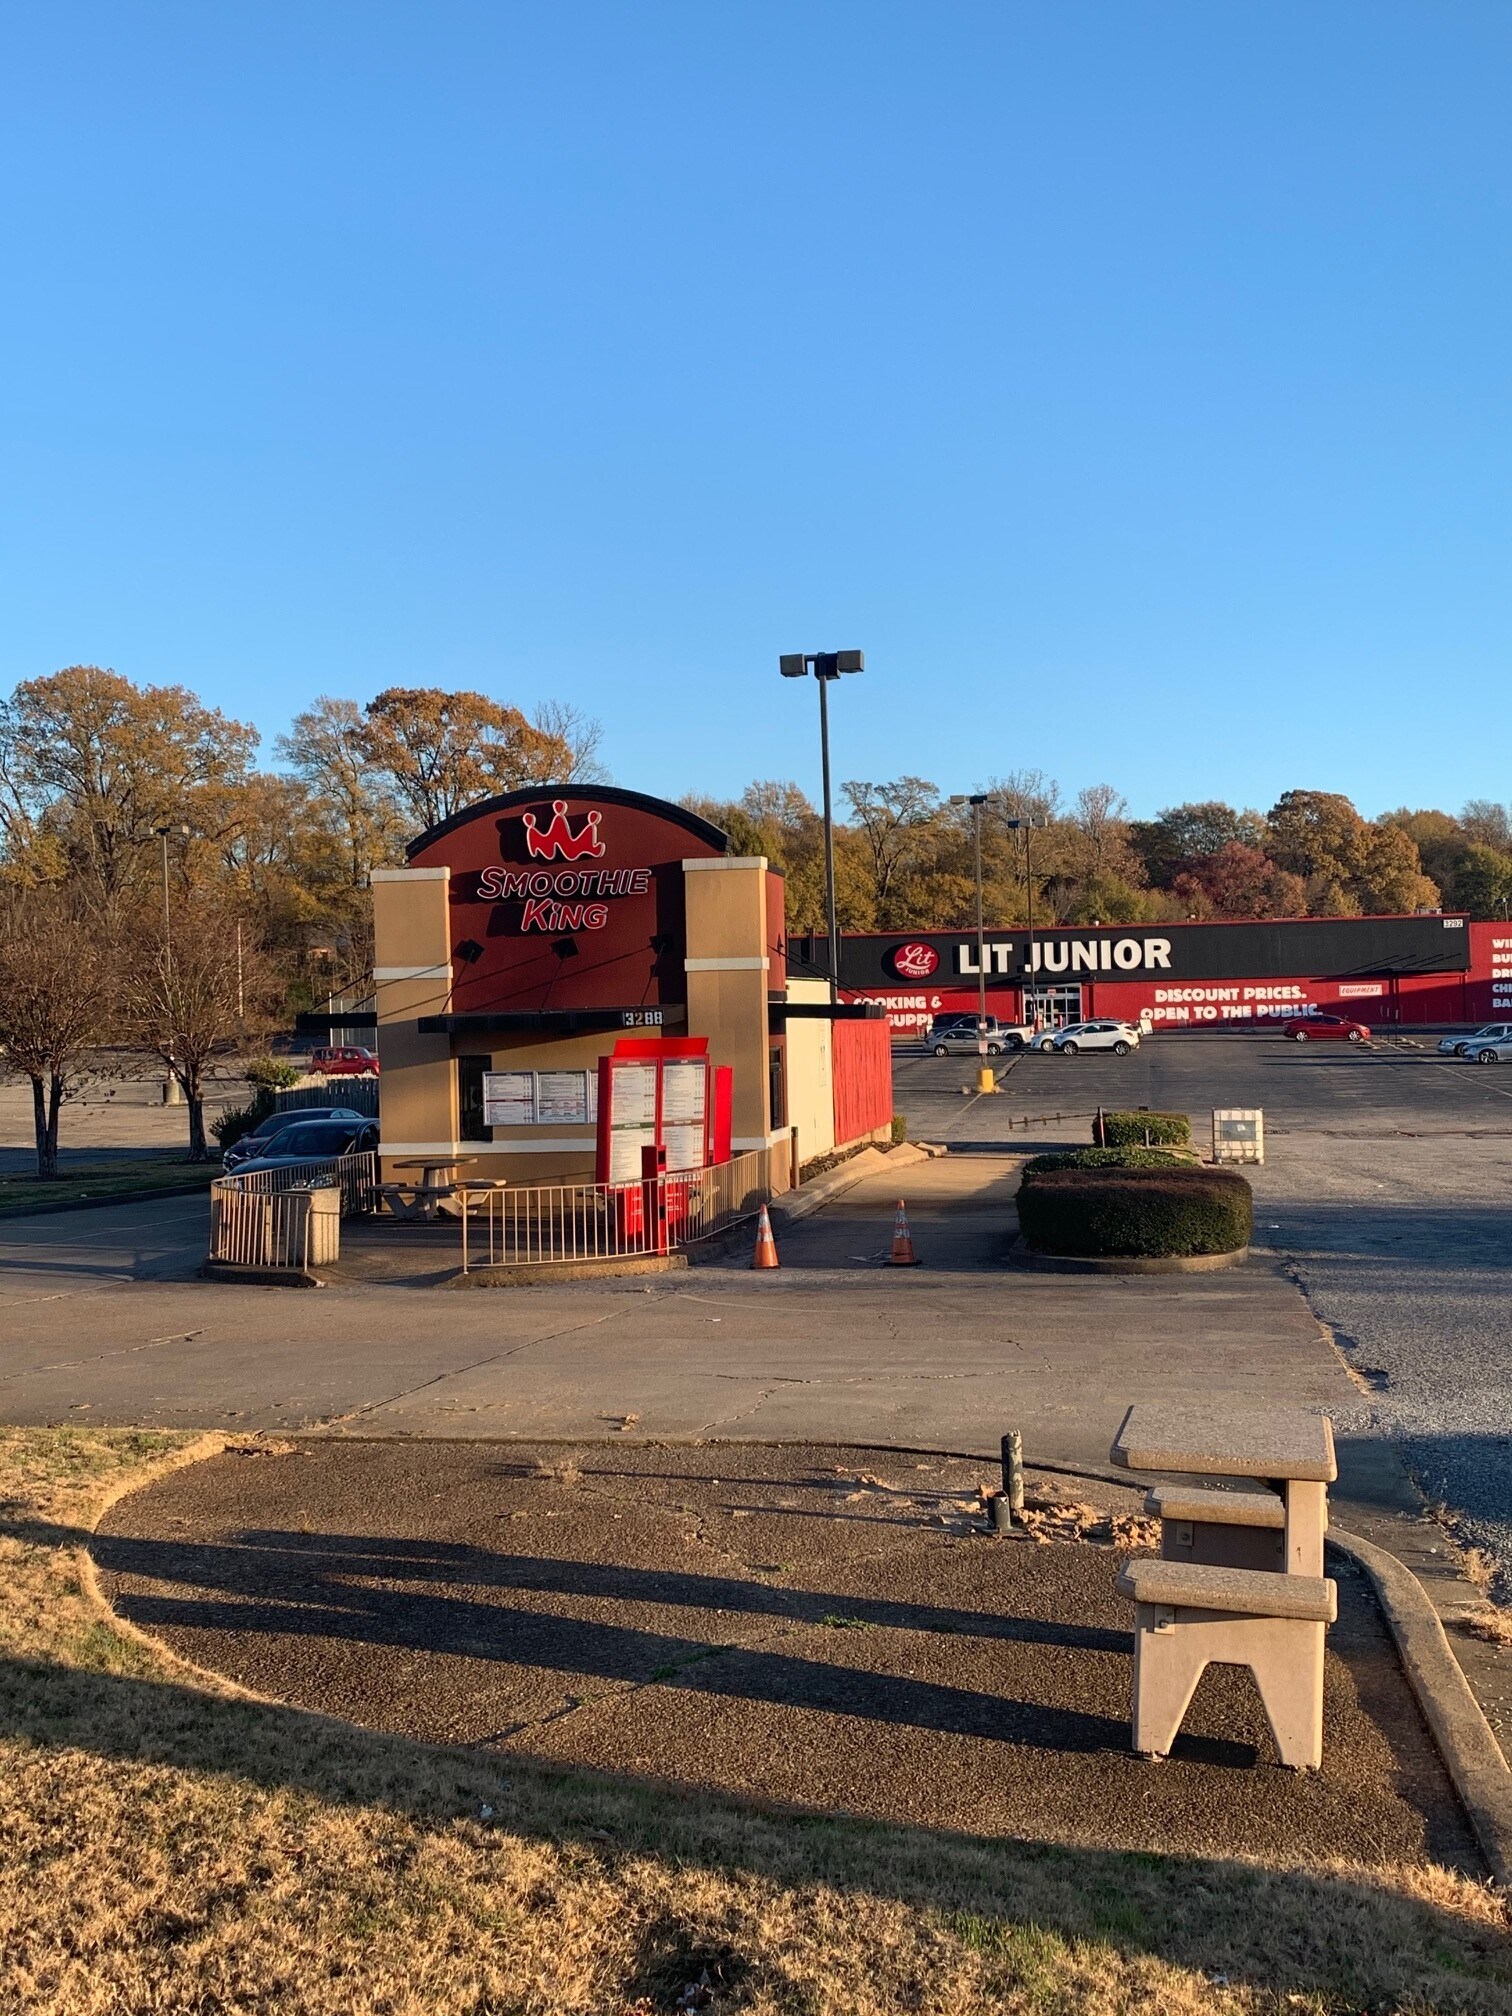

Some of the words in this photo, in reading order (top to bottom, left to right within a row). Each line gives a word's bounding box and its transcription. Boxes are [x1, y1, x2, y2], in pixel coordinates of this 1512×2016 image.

[477, 866, 652, 899] SMOOTHIE
[896, 945, 935, 970] Lit
[959, 943, 1013, 974] LIT
[1024, 938, 1172, 973] JUNIOR
[905, 967, 930, 976] JUNIOR
[1155, 988, 1239, 1003] DISCOUNT
[1243, 986, 1307, 1000] PRICES.
[1341, 986, 1380, 994] EQUIPMENT
[930, 995, 942, 1008] &
[625, 1011, 663, 1026] 3288
[1140, 1006, 1190, 1021] OPEN
[1194, 1005, 1217, 1019] TO
[1221, 1005, 1252, 1018] THE
[1257, 1003, 1323, 1017] PUBLIC.
